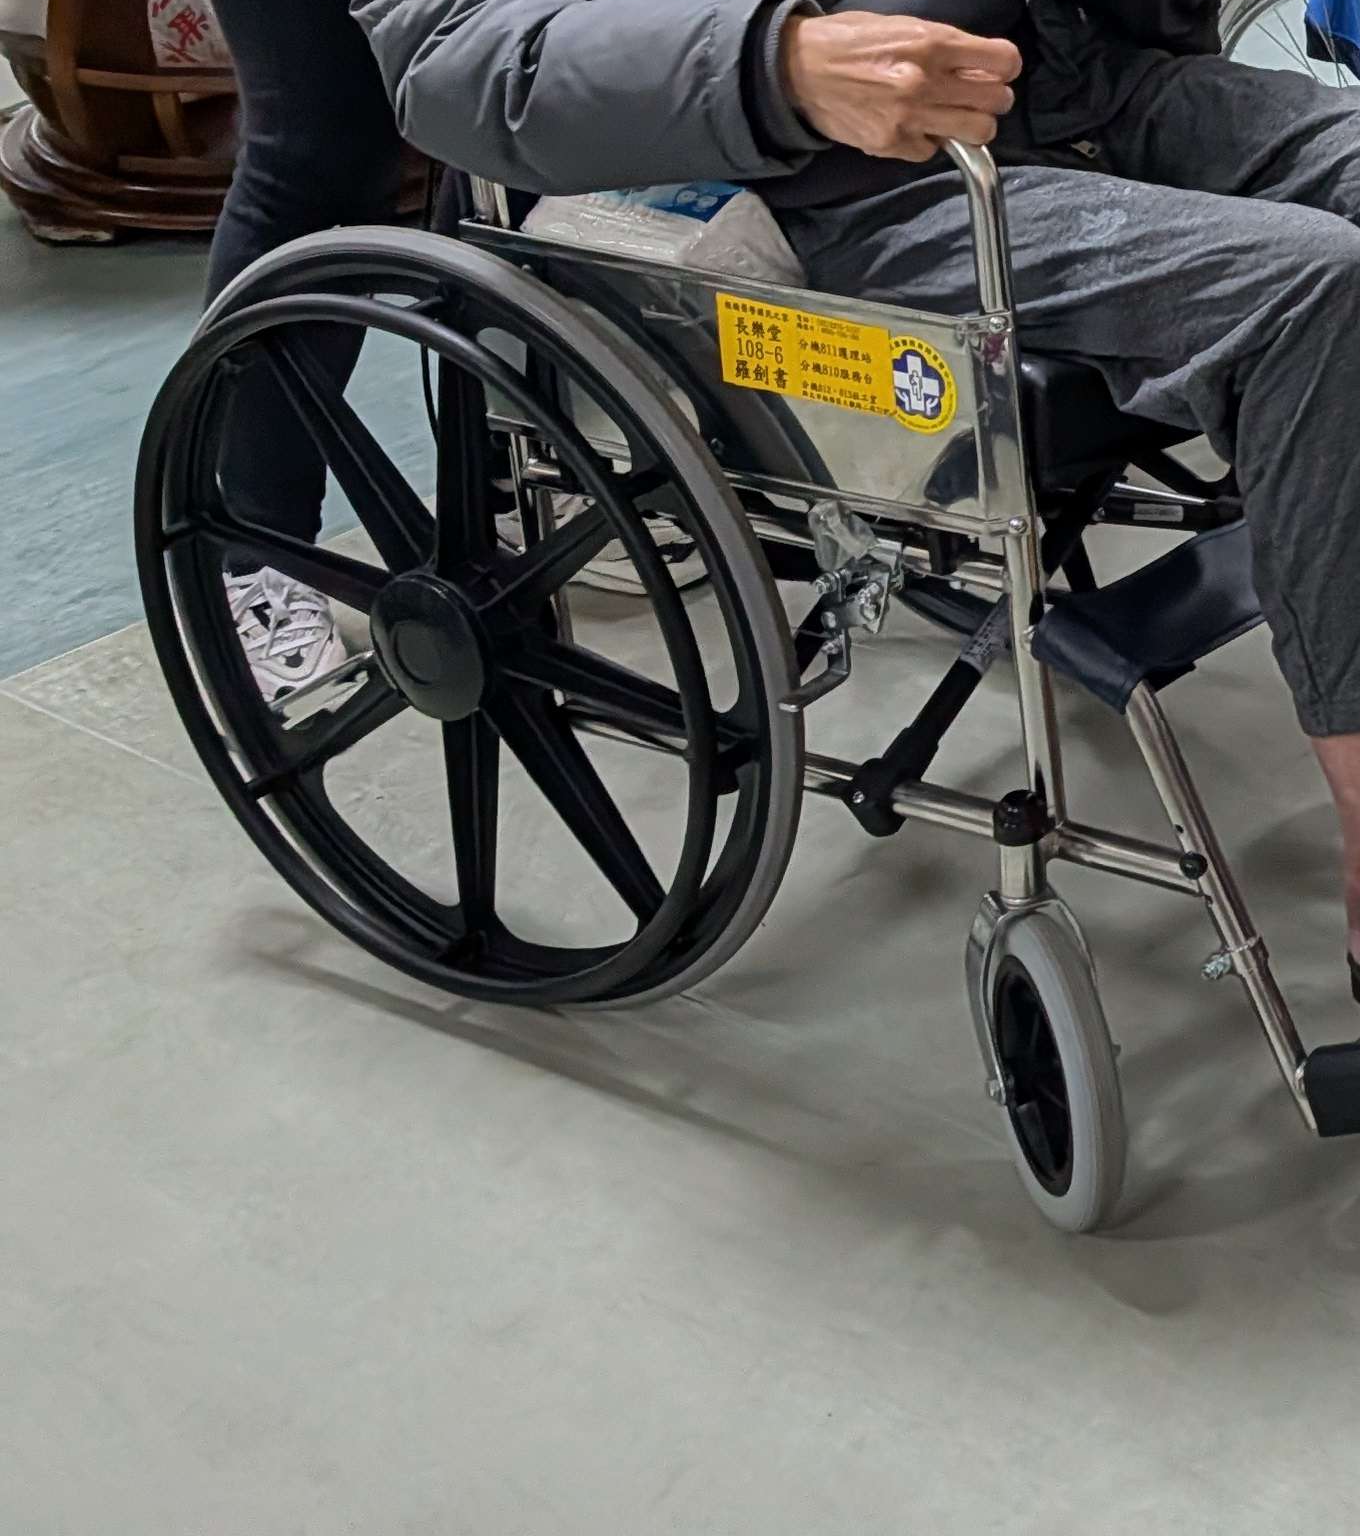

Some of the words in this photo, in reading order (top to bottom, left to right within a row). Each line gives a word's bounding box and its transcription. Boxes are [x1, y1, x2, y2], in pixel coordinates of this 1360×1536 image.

[736, 317, 782, 342] 長樂堂
[737, 337, 783, 364] 108-6
